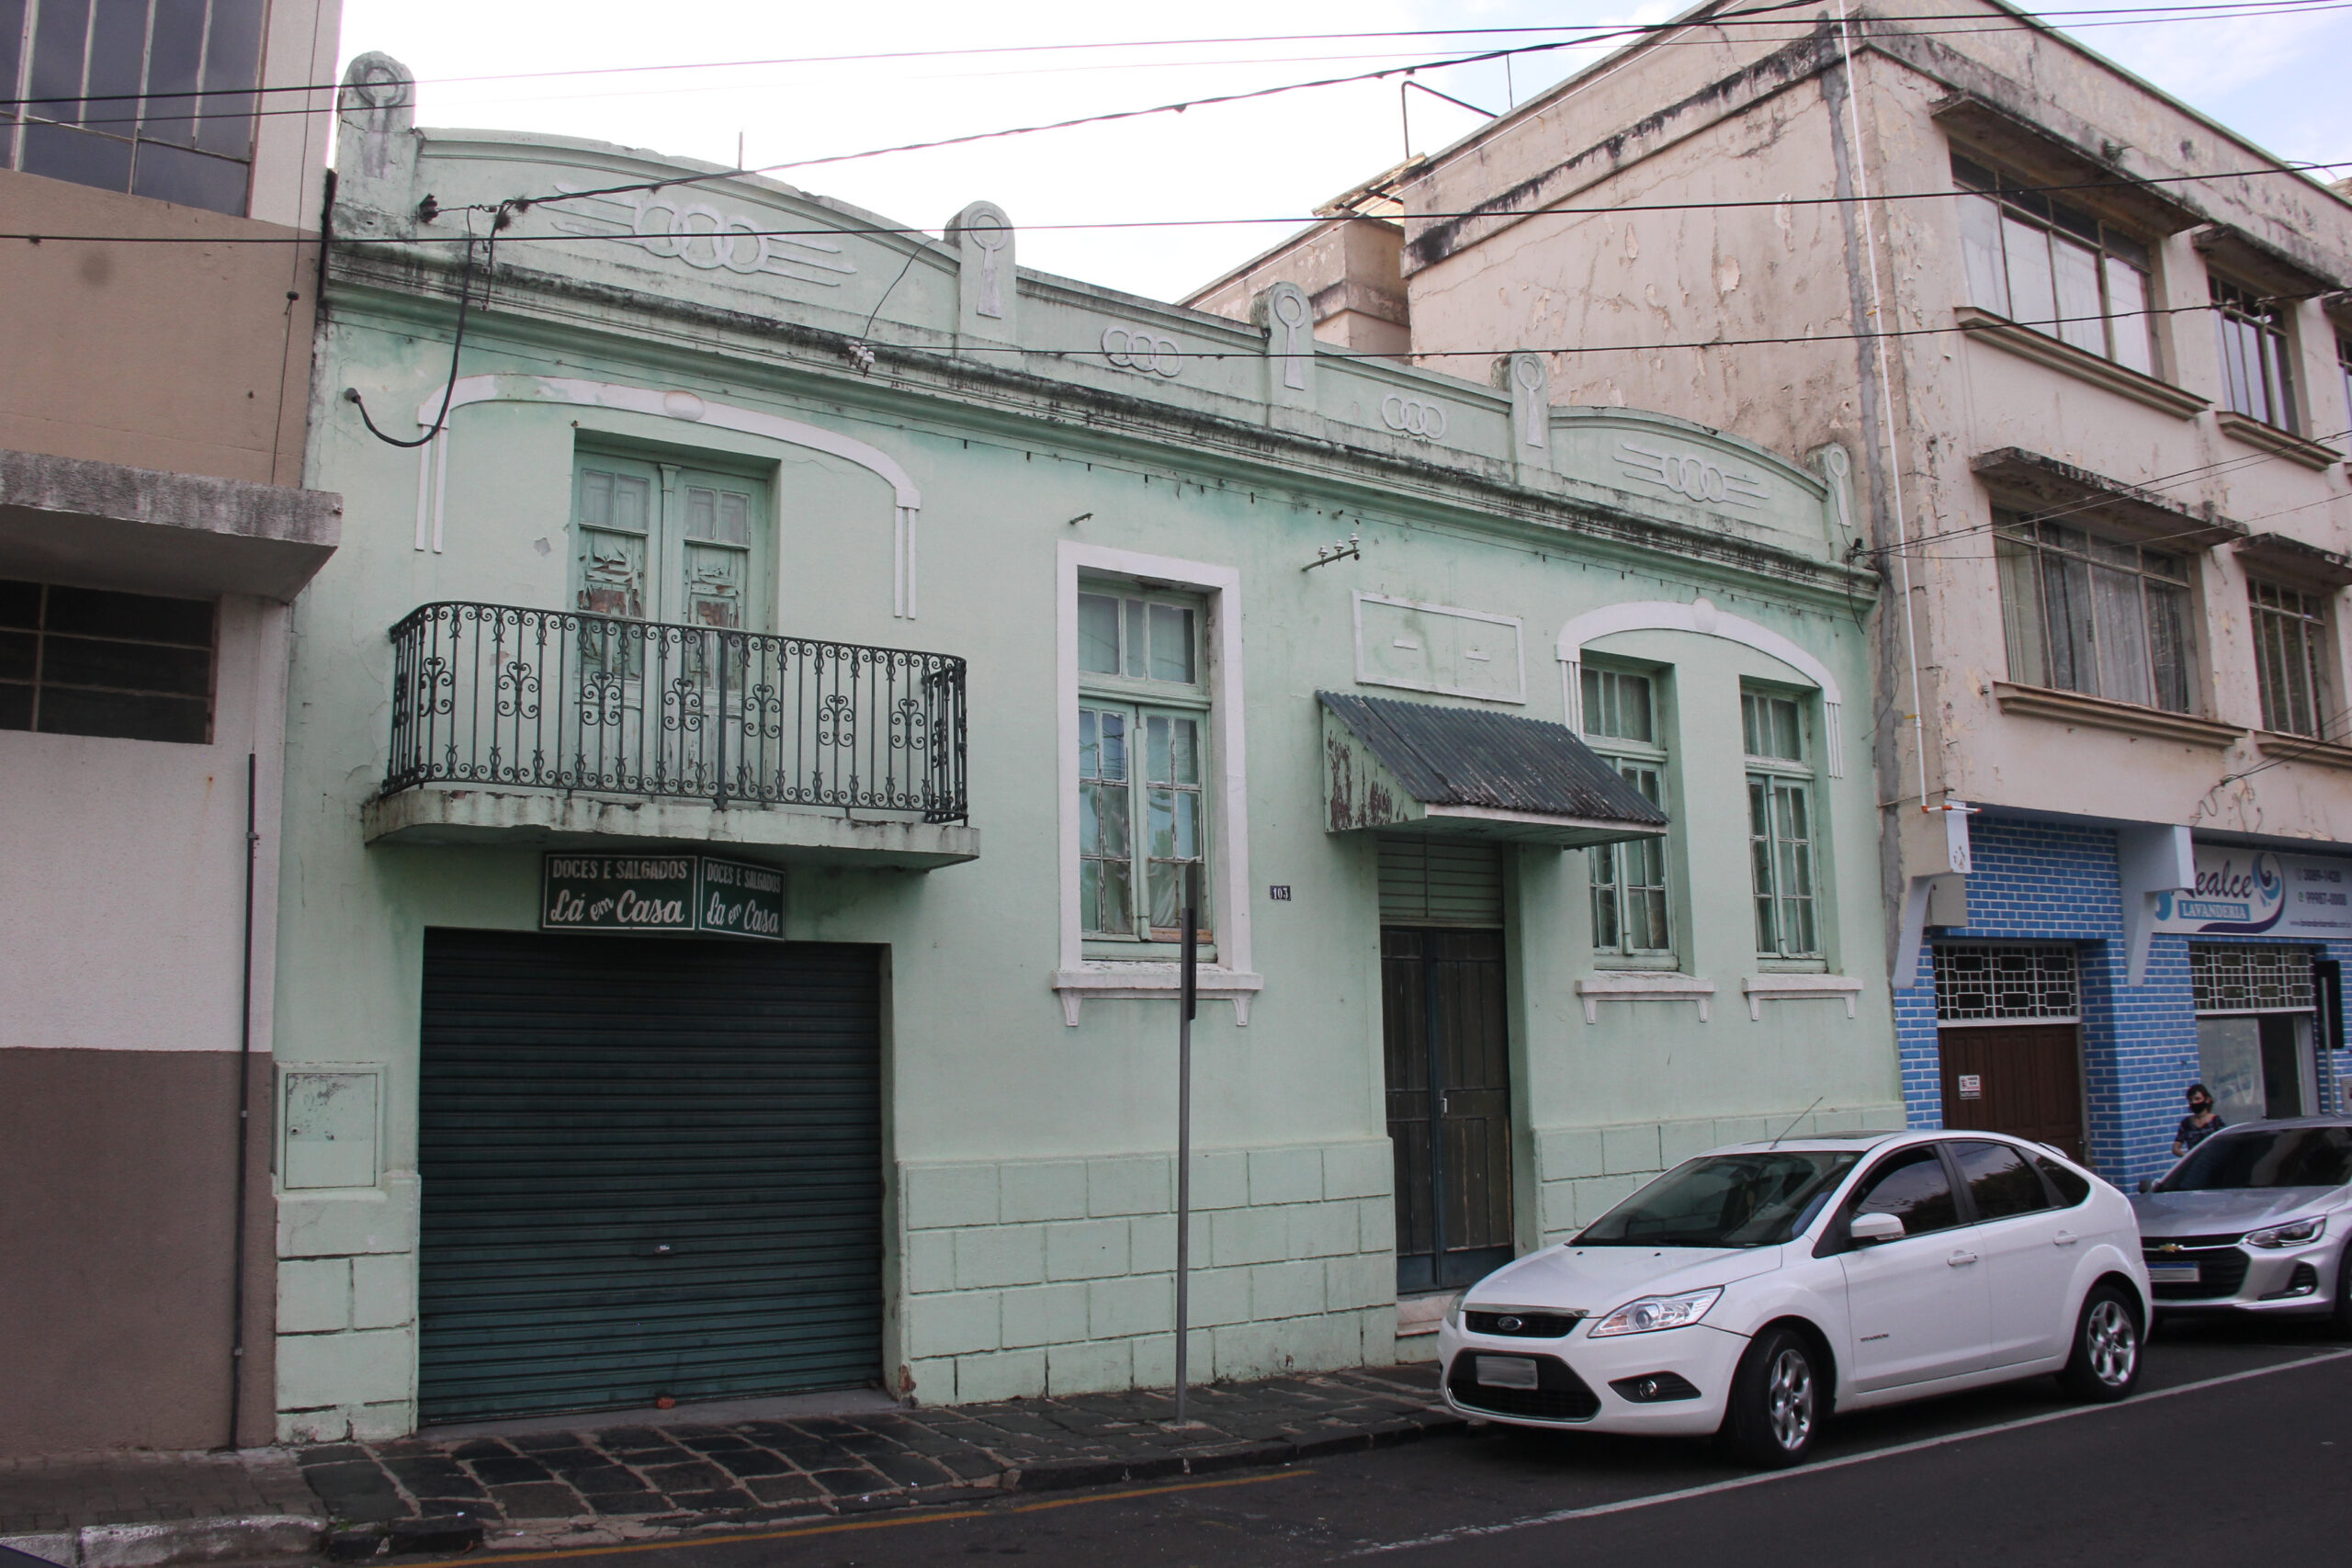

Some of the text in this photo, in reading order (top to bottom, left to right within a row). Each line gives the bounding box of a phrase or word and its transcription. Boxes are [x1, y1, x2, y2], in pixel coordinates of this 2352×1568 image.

[552, 860, 687, 880] DOCES E SALGADOS
[707, 863, 781, 893] DOCES E SALGADOS
[590, 897, 615, 921] em
[616, 889, 685, 924] Casa
[729, 903, 742, 925] em
[743, 899, 780, 934] Casa
[2182, 902, 2247, 919] LAVANDERIA
